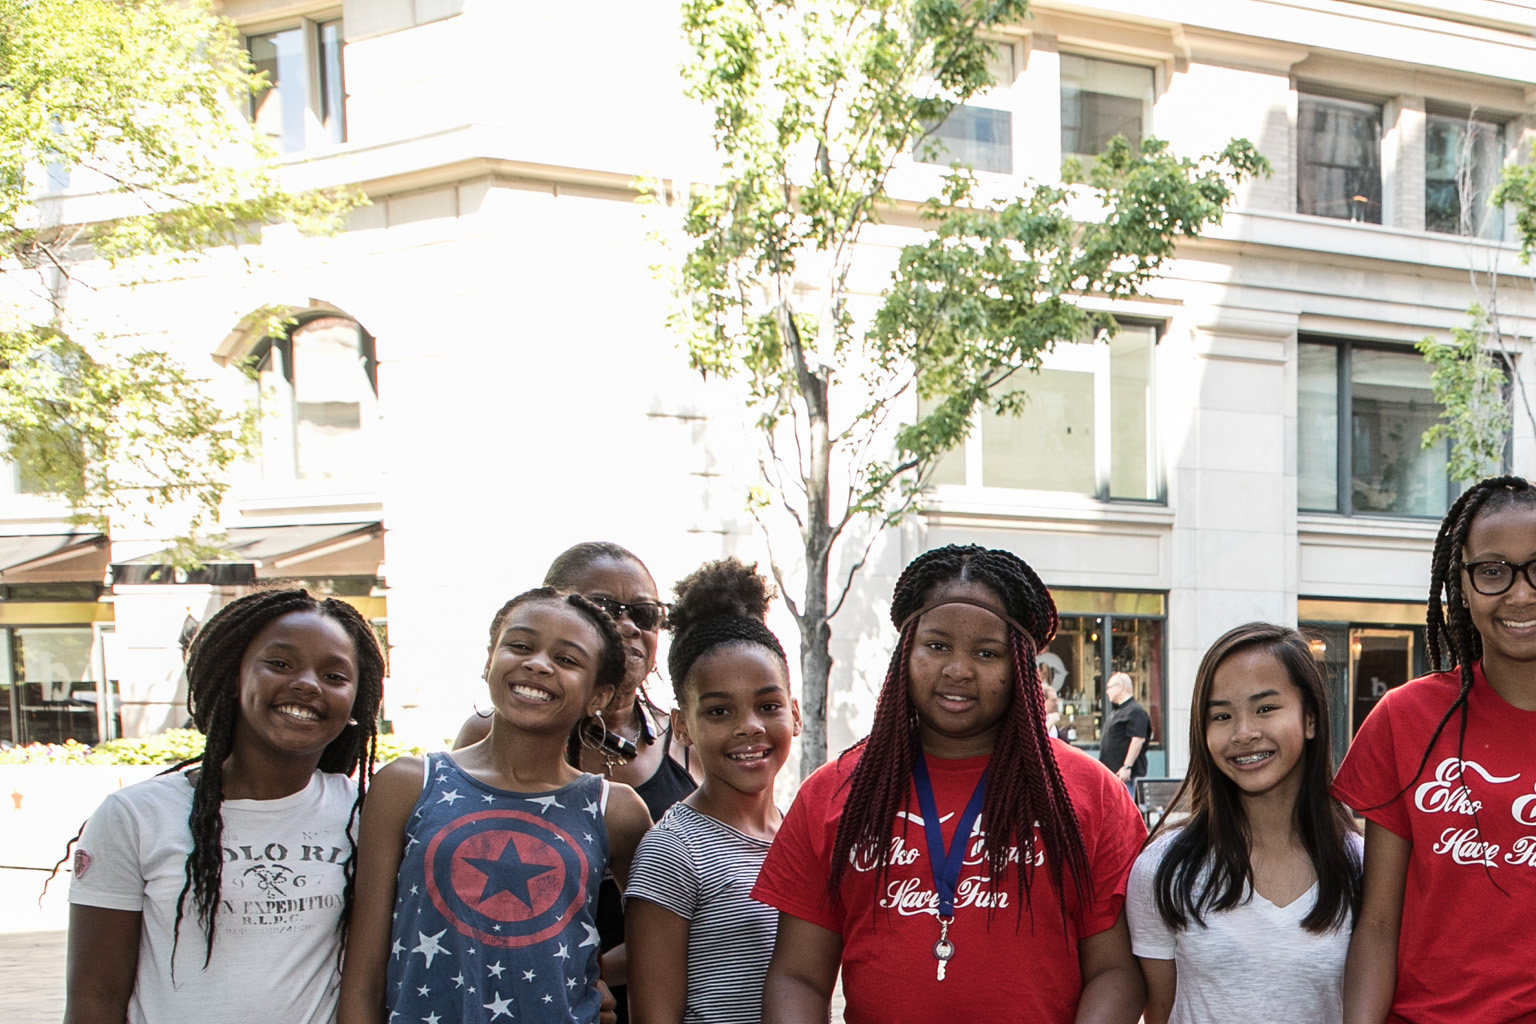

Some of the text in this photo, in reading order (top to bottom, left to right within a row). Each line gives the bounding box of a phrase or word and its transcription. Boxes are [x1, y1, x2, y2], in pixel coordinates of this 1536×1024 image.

[1414, 757, 1521, 815] Elko
[1432, 827, 1500, 868] Have
[880, 875, 1009, 916] Have Fun
